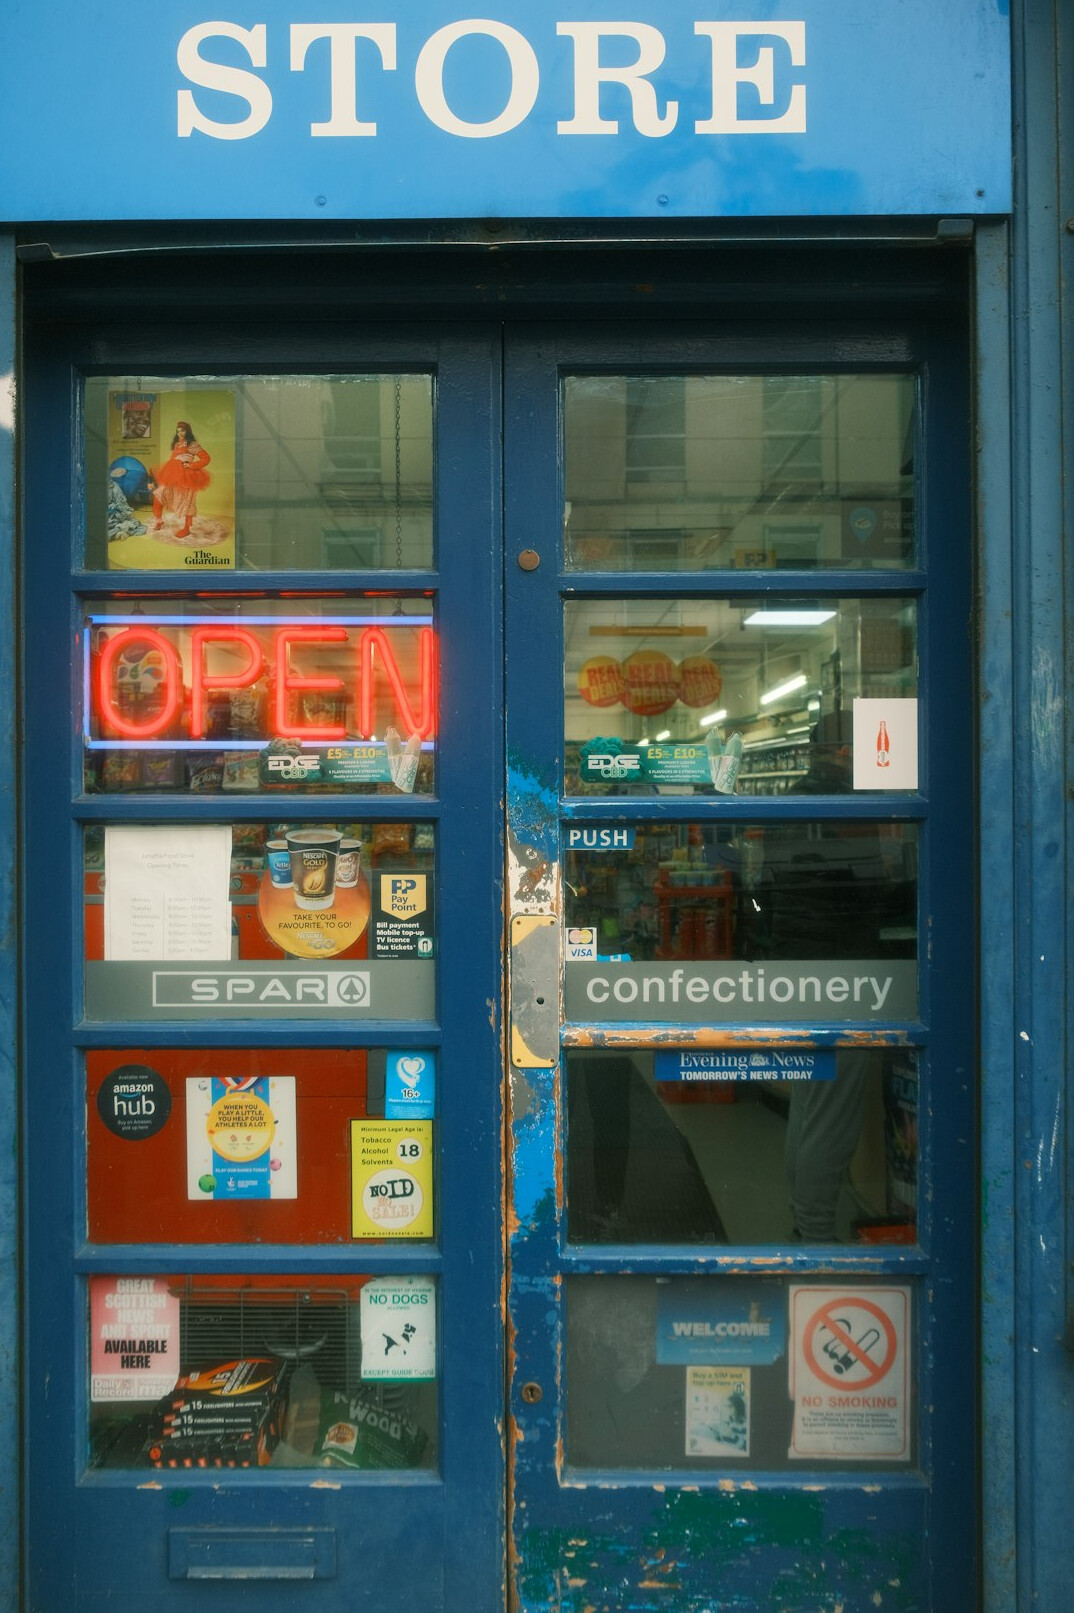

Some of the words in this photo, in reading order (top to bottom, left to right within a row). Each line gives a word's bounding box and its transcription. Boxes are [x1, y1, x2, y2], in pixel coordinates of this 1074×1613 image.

[176, 19, 807, 139] STORE
[193, 550, 211, 558] The
[185, 557, 230, 565] Guardian
[99, 627, 434, 738] OPEN
[327, 748, 341, 760] £5
[353, 747, 375, 759] £10
[647, 748, 662, 759] £5
[674, 748, 696, 759] £10
[268, 755, 320, 771] EDGE
[588, 754, 640, 770] EDGE
[281, 767, 308, 779] CBD
[601, 767, 627, 779] CBD
[569, 830, 628, 847] PUSH
[391, 895, 408, 905] Pay
[391, 903, 416, 911] Point
[337, 921, 352, 929] GO!
[389, 922, 420, 930] payment
[571, 948, 593, 957] VISA
[191, 978, 326, 1001] SPAR
[586, 969, 893, 1010] confectionery
[680, 1052, 749, 1070] Evening
[771, 1052, 815, 1067] News
[680, 1071, 748, 1080] TOMORROW'S
[750, 1071, 778, 1080] NEWS
[780, 1071, 813, 1080] TODAY
[113, 1083, 154, 1093] amazon
[401, 1088, 420, 1098] 16+
[113, 1095, 156, 1116] hub
[400, 1145, 420, 1157] 18
[116, 1279, 156, 1294] GREAT
[105, 1293, 168, 1309] SCOTTISH
[369, 1294, 388, 1305] NO
[392, 1294, 428, 1305] DOGS
[117, 1309, 155, 1323] NEWS
[101, 1325, 127, 1338] AND
[131, 1324, 171, 1338] SPORT
[672, 1322, 770, 1337] WELCOME
[104, 1340, 168, 1354] AVAILABLE
[120, 1355, 151, 1369] HERE
[94, 1380, 118, 1389] Daily
[94, 1388, 134, 1397] Record
[191, 1401, 202, 1410] 15
[802, 1396, 823, 1408] NO
[828, 1396, 897, 1408] SMOKING
[183, 1415, 193, 1424] 15
